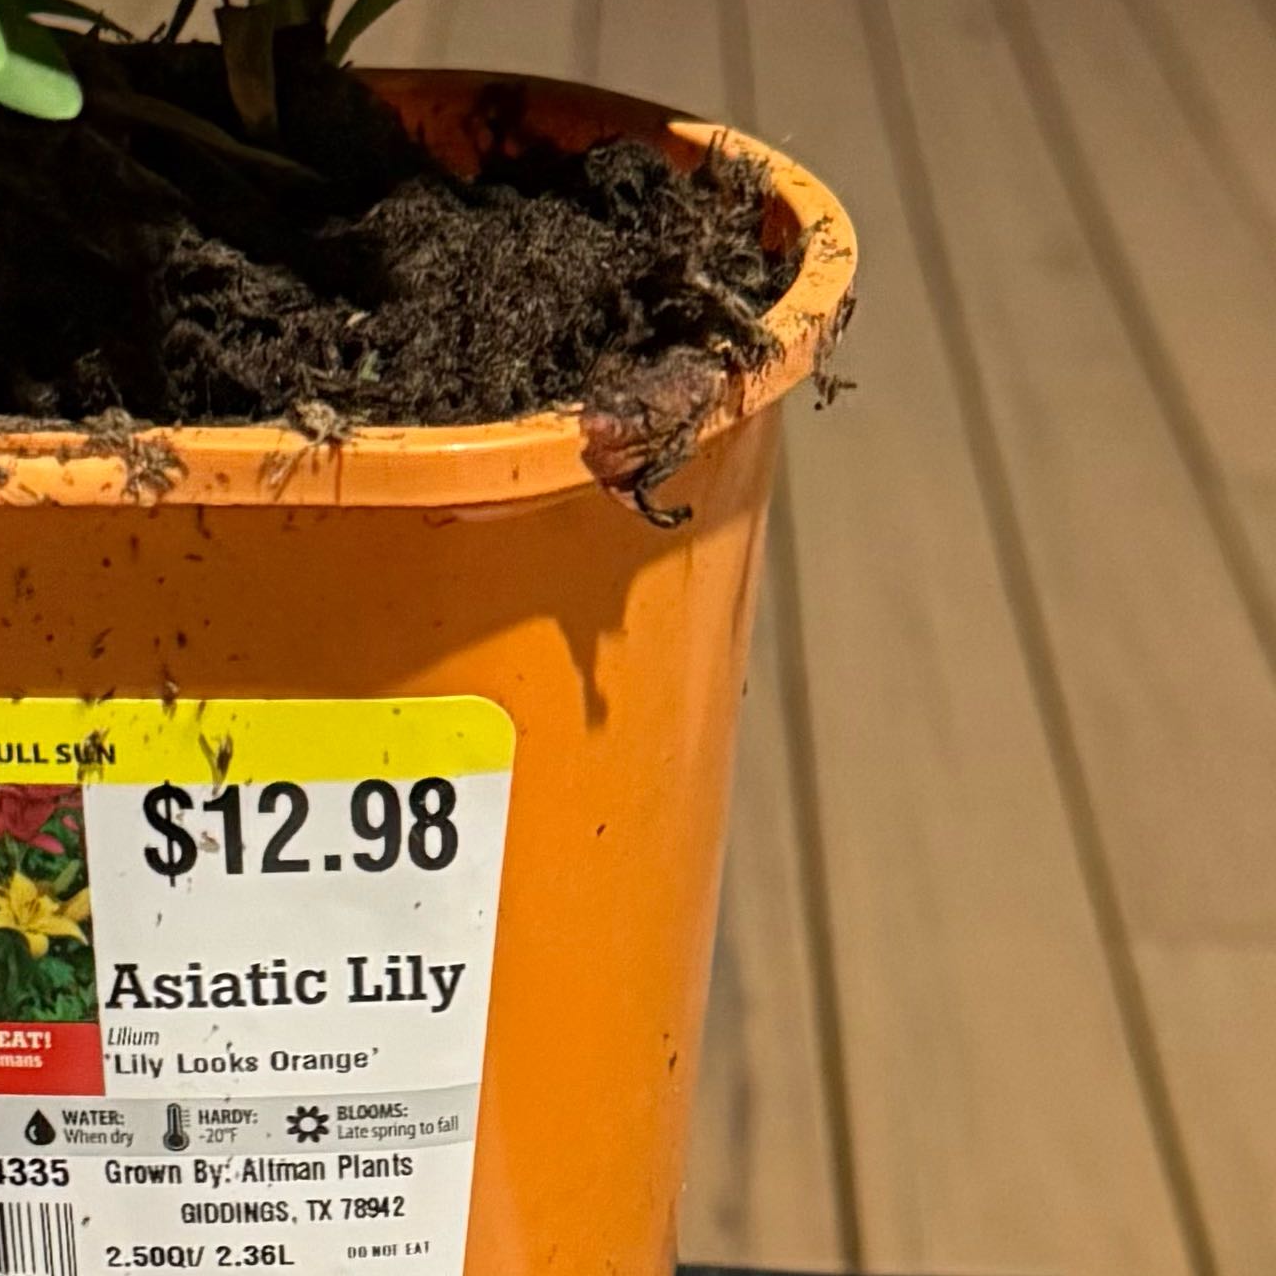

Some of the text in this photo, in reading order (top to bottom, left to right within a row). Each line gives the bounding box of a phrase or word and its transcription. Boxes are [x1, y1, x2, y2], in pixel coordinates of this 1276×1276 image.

[56, 743, 116, 765] SUN
[143, 777, 459, 887] $12.98
[105, 955, 466, 1012] Asiatic Lily
[107, 1027, 160, 1046] Lilium
[177, 1052, 259, 1074] Looks
[62, 1110, 125, 1126] WATER:
[198, 1109, 258, 1125] HARDY:
[337, 1103, 409, 1121] BLOOMS:
[64, 1128, 134, 1147] When dry
[337, 1115, 459, 1141] Late spring to fall
[105, 1154, 414, 1189] Grown By: Altman Plants
[181, 1196, 406, 1225] GIDDINGS, TX 78942
[215, 1245, 294, 1267] 2.36L
[347, 1241, 430, 1259] DO NOT EAT
